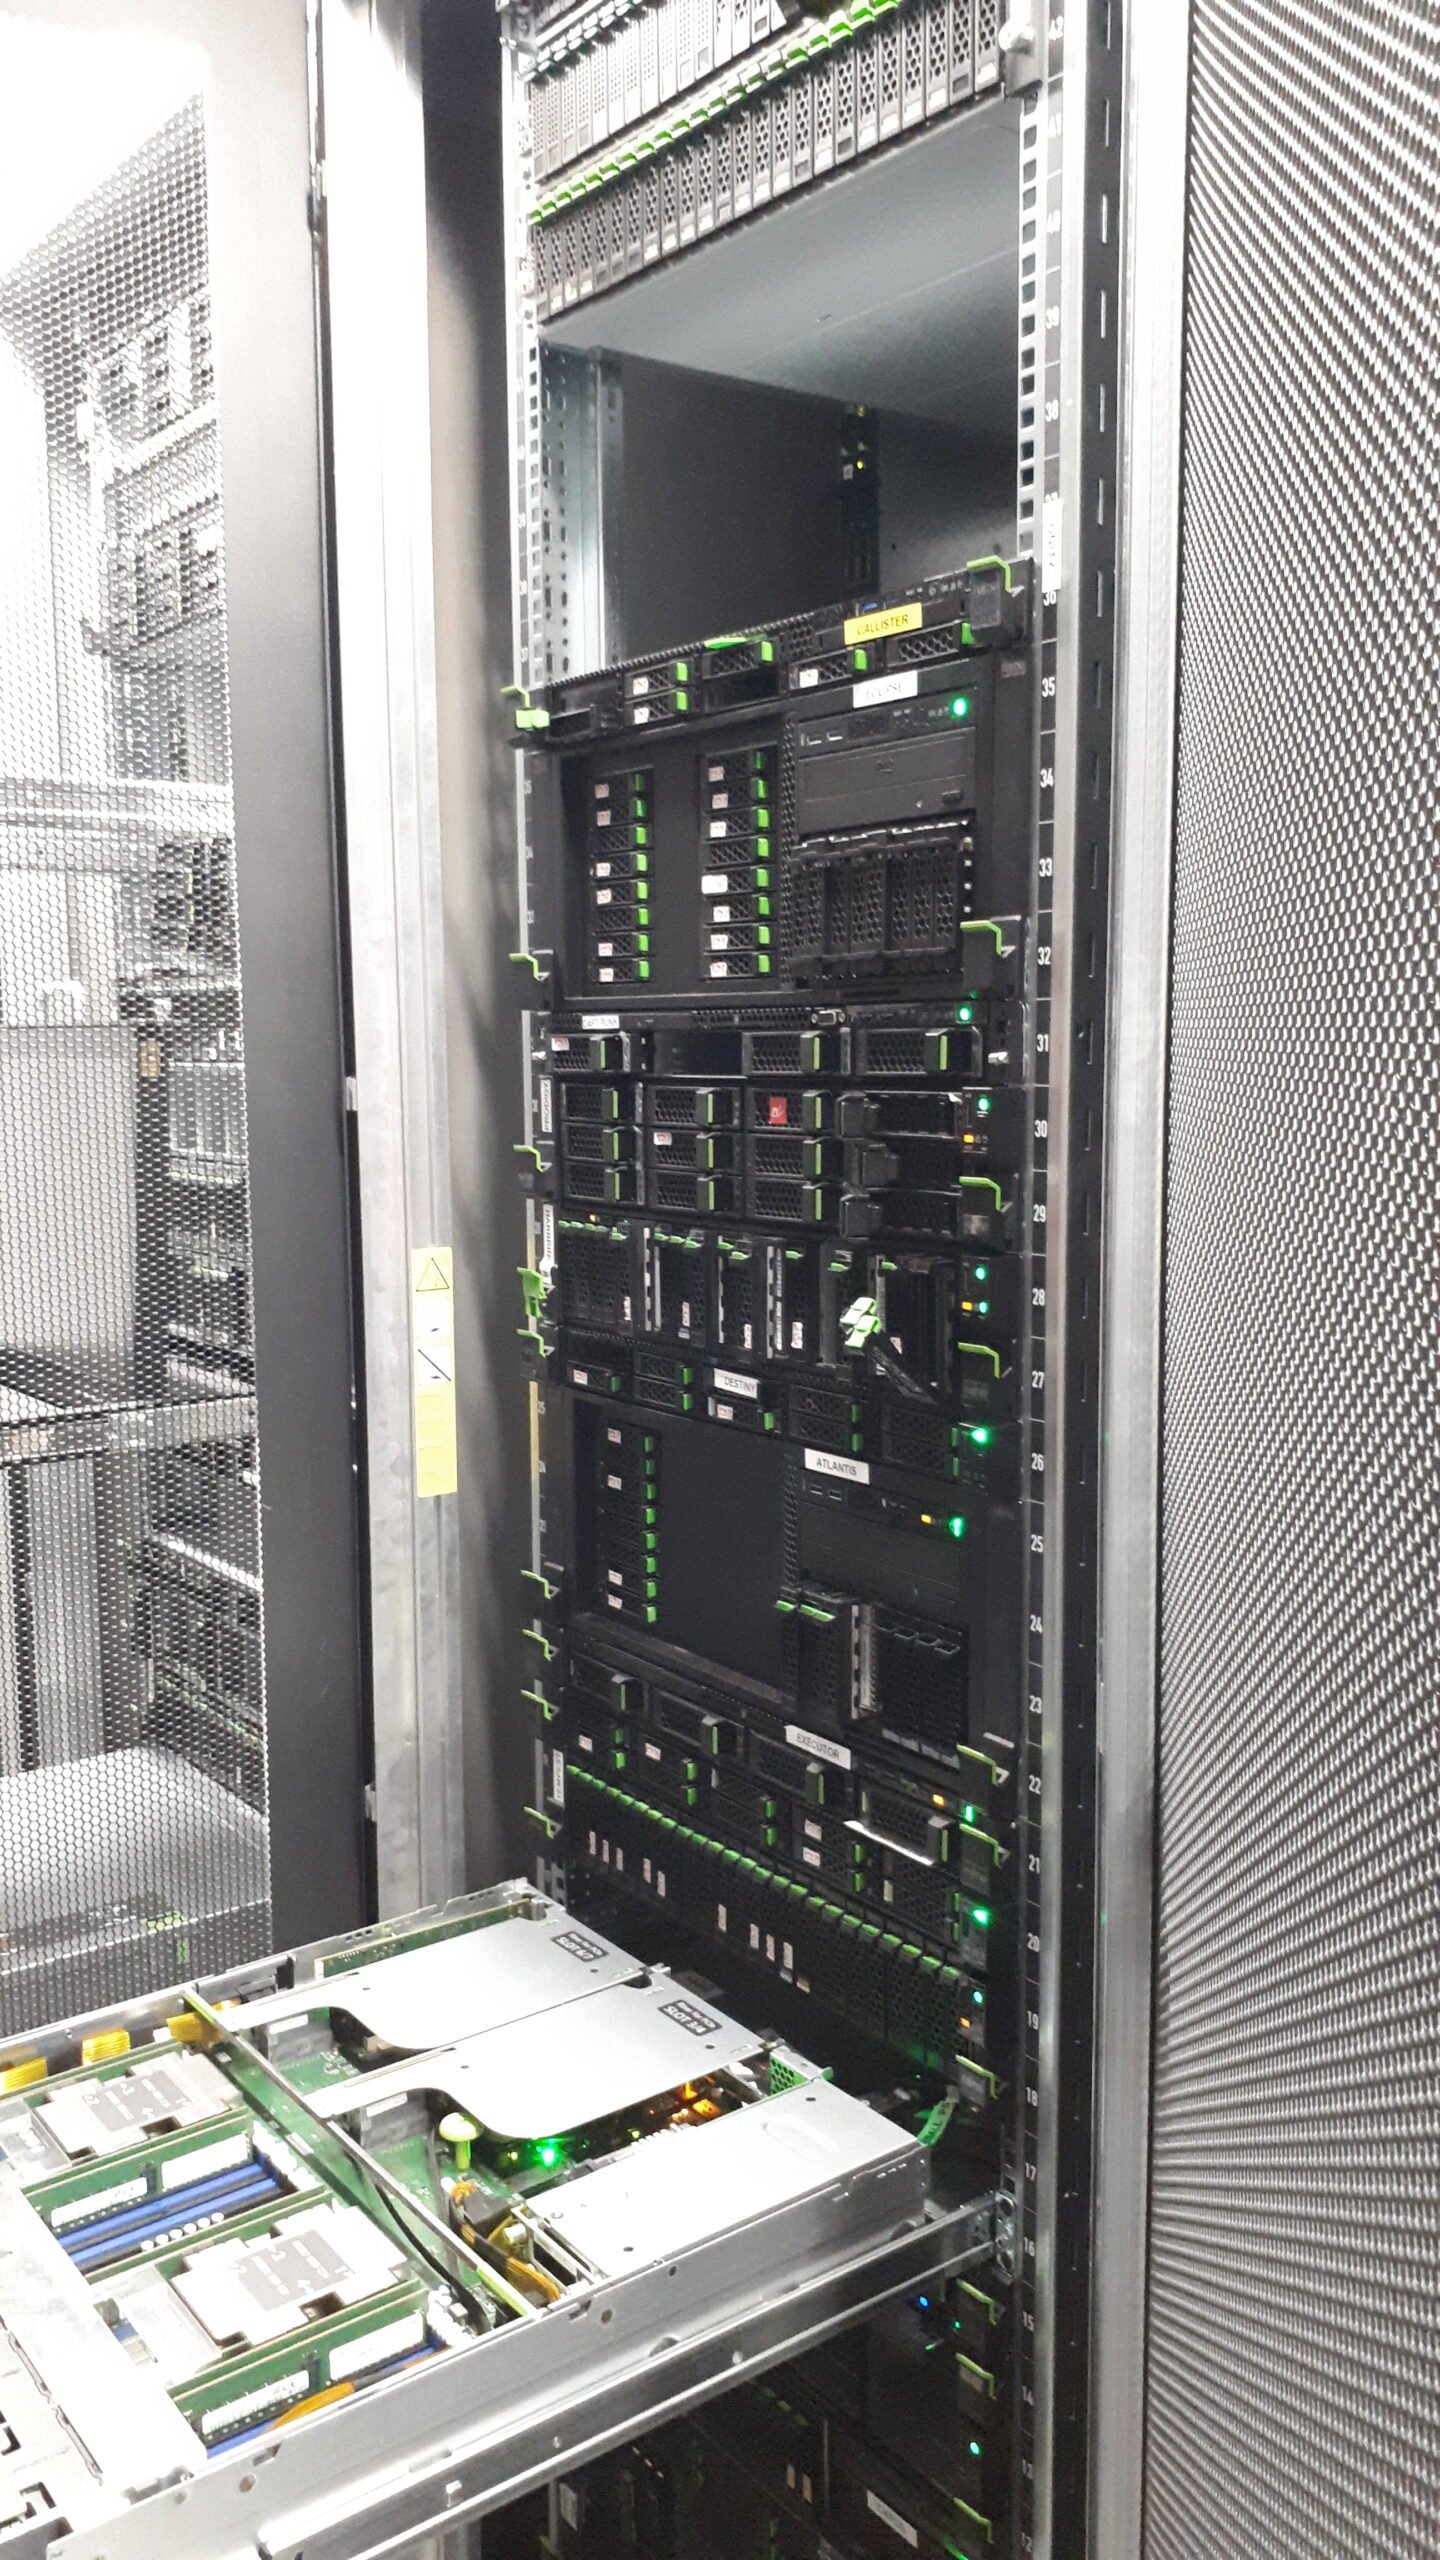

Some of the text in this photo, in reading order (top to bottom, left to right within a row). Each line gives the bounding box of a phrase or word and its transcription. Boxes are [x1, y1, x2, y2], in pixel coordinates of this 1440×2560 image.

[1045, 305, 1059, 329] 39
[1045, 398, 1059, 423] 38
[857, 613, 909, 636] CALLISTER
[1042, 676, 1056, 698] 35
[1040, 767, 1054, 788] 34
[1038, 857, 1053, 878] 33
[1037, 946, 1052, 966] 32
[1036, 1033, 1049, 1053] 31
[1034, 1119, 1048, 1138] 30
[1033, 1204, 1046, 1223] 29
[1032, 1288, 1045, 1307] 28
[723, 1376, 755, 1393] DESTINY
[1031, 1370, 1045, 1389] 27
[816, 1457, 857, 1476] ATLANTIS
[1031, 1452, 1044, 1472] 26
[1030, 1533, 1044, 1553] 25
[1029, 1614, 1043, 1634] 24
[1029, 1694, 1042, 1714] 23
[796, 1732, 840, 1760] EXECUTOR
[1028, 1775, 1042, 1795] 22
[1028, 1854, 1041, 1874] 21
[1027, 1932, 1040, 1953] 20
[664, 2005, 690, 2023] SLOT
[1027, 2010, 1039, 2030] 19
[1026, 2086, 1038, 2107] 18
[1025, 2162, 1037, 2182] 17
[1024, 2236, 1035, 2257] 16
[1023, 2311, 1034, 2332] 15
[1022, 2385, 1034, 2407] 14
[1022, 2459, 1033, 2480] 13
[1021, 2532, 1033, 2553] 12
